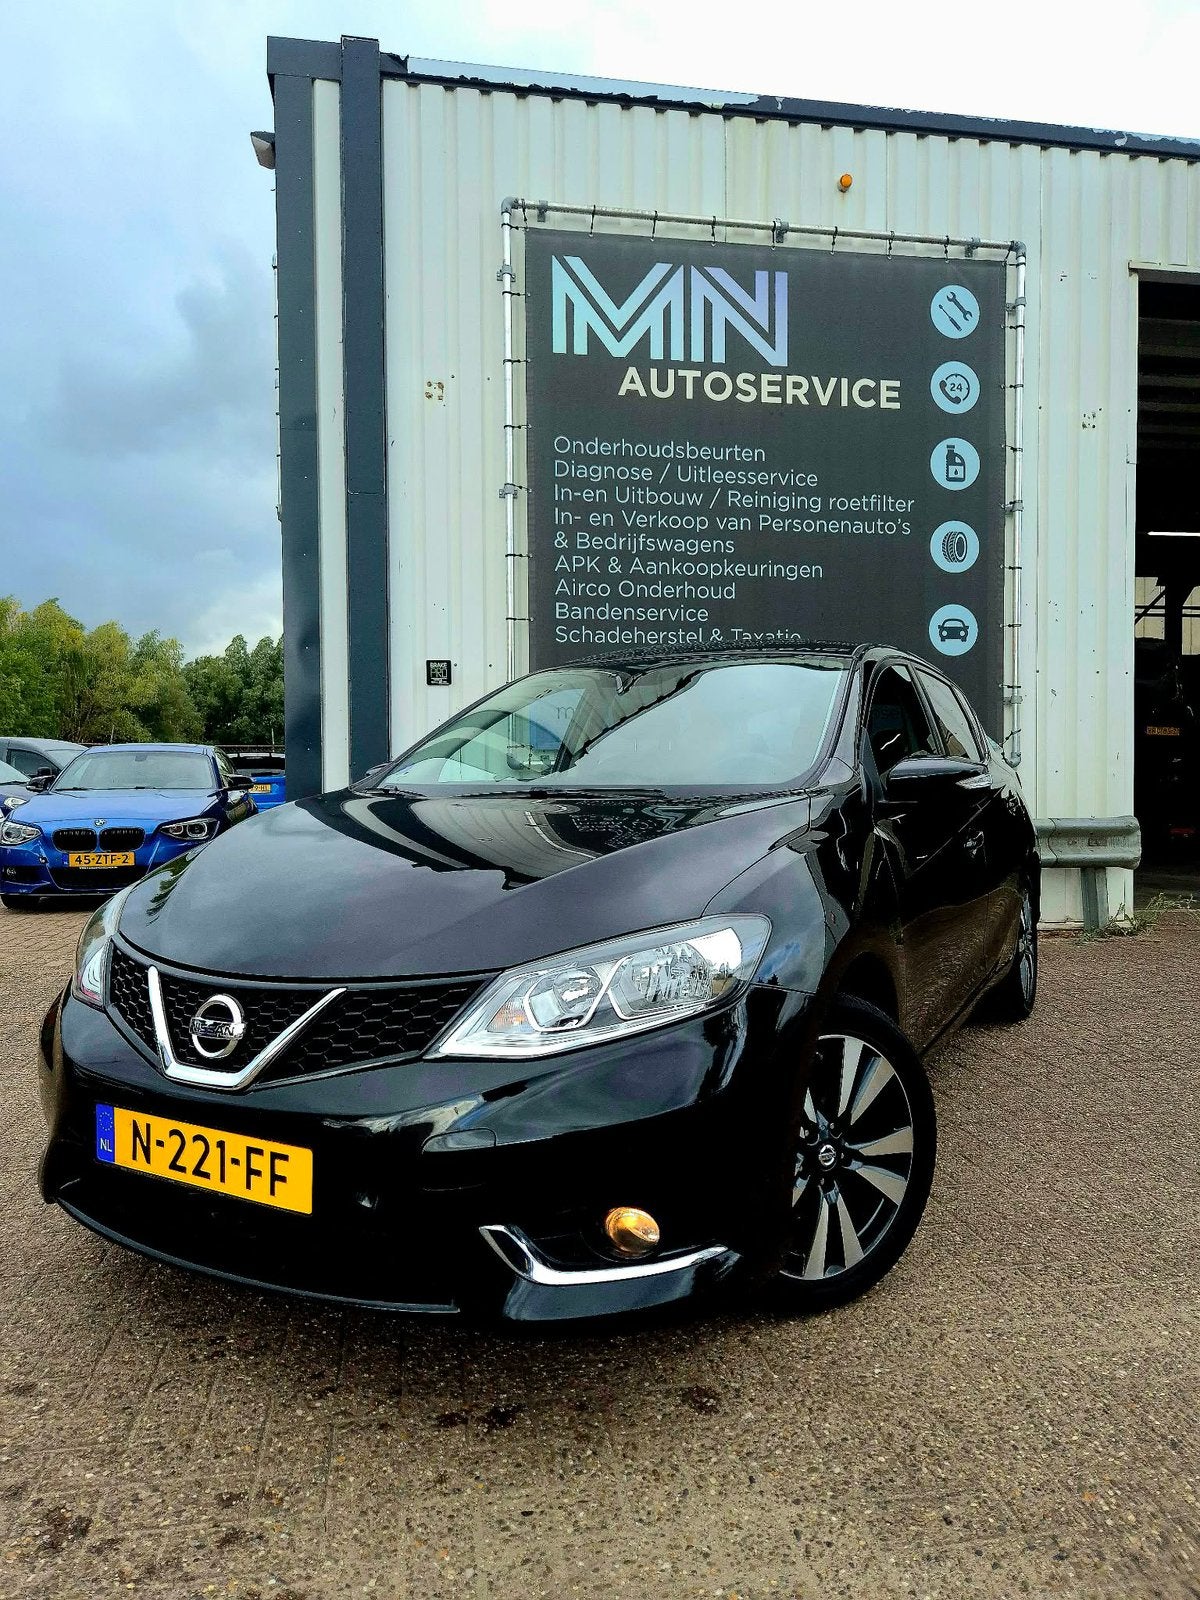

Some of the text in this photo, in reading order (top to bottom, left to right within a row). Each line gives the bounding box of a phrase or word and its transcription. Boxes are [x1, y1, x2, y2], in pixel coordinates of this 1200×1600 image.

[618, 366, 900, 409] AUTOSERVICE
[950, 382, 963, 392] 24
[554, 436, 766, 462] Onderhoudsbeurten
[554, 460, 818, 487] Diagnose / Uitleesservice
[554, 484, 915, 513] In-en Uitbouw / Reiniging roetfilter
[554, 508, 911, 535] In- en Verkoop van Personenauto's
[554, 531, 735, 556] & Bedrijfswagens
[554, 555, 823, 580] APK & Aankoopkeuringen
[554, 579, 736, 599] Airco Onderhoud
[555, 602, 709, 622] Bandenservice
[555, 626, 703, 644] Schadeherstel
[100, 1137, 113, 1152] NL
[132, 1119, 290, 1197] N-221-FF
